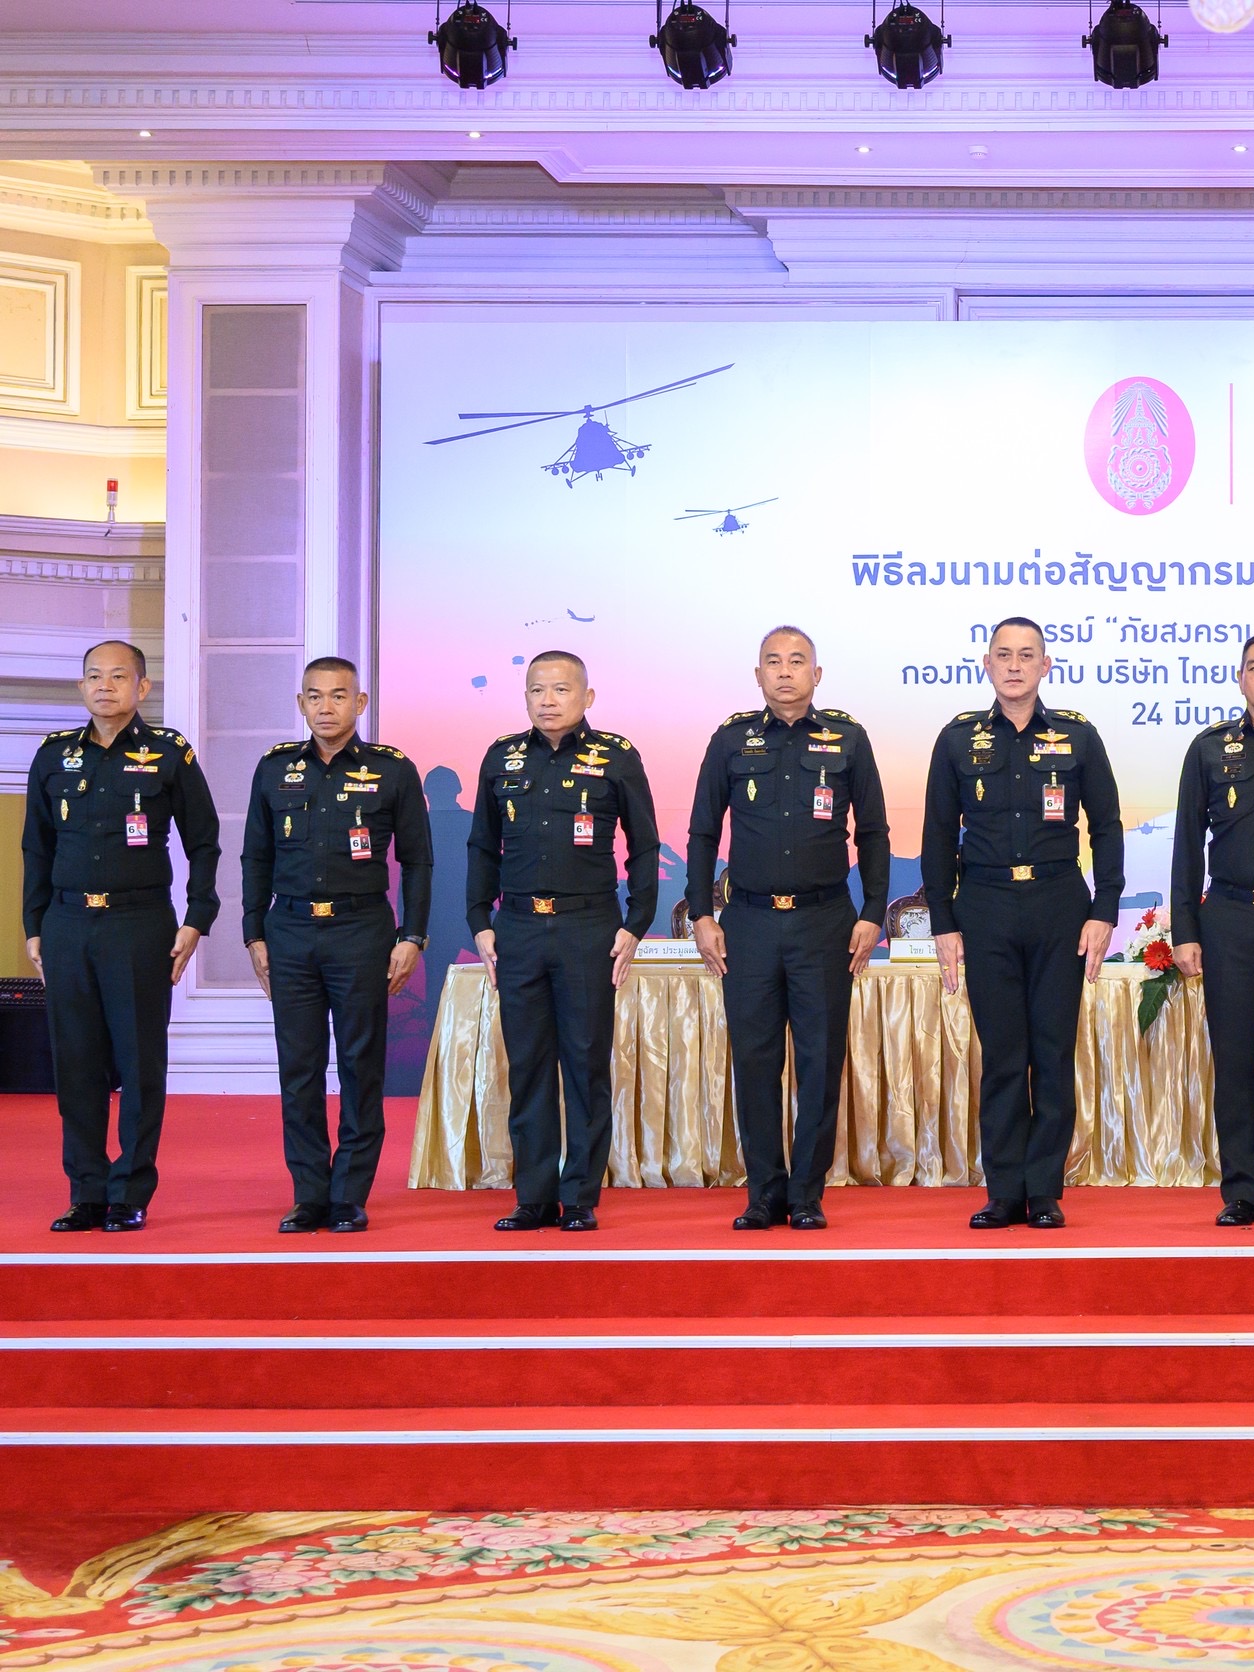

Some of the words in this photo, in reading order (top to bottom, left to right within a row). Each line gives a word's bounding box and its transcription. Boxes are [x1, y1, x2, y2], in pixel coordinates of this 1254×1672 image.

[970, 616, 1094, 643] กรรม์
[1097, 657, 1169, 684] บริษัท
[1132, 702, 1163, 725] 24
[1175, 697, 1245, 725] มีนาค
[816, 798, 822, 807] 6
[1046, 799, 1053, 807] 6
[128, 825, 135, 834] 6
[576, 824, 583, 833] 6
[352, 839, 359, 848] 6
